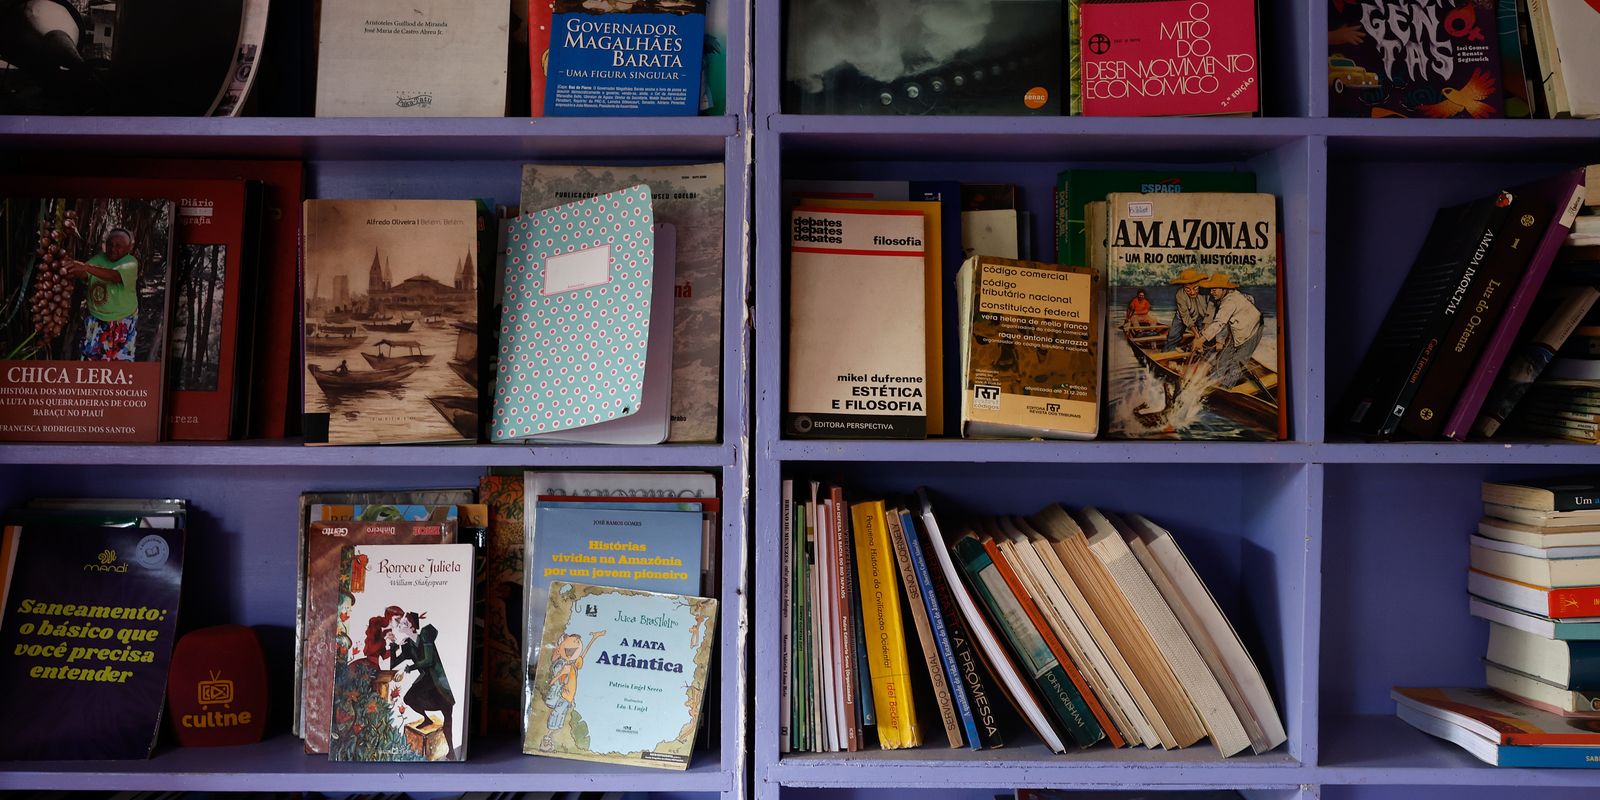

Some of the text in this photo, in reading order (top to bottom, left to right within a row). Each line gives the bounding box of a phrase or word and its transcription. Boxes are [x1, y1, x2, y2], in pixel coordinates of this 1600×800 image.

[1189, 2, 1210, 21] O
[566, 18, 678, 36] GOVERNADOR
[1160, 20, 1211, 40] MITO
[563, 31, 684, 52] MAGALHÃES
[1177, 38, 1211, 58] DO
[612, 50, 684, 69] BARATA
[1086, 54, 1255, 80] DESENVOLVIMENTO
[566, 70, 680, 80] UMA FIGURA SINGULAR
[1086, 75, 1219, 99] ECONÔMICO
[1231, 77, 1255, 99] EDIÇÃO
[181, 198, 214, 207] Diário
[793, 217, 843, 228] debates
[793, 225, 843, 236] debates
[793, 232, 843, 245] debates
[874, 235, 922, 247] filosofia
[1111, 218, 1270, 251] AMAZONAS
[1126, 252, 1257, 266] UM RIO CONTA HISTÓRIAS
[983, 266, 1068, 281] código comercial
[1444, 229, 1496, 318] AMADA IMORTAL
[982, 279, 1017, 290] código
[982, 288, 1073, 304] tributário nacional
[981, 301, 1080, 319] constituição federal
[1454, 279, 1501, 353] Luz do Oriente
[1000, 315, 1027, 324] helena
[1028, 317, 1039, 325] de
[1041, 319, 1062, 328] mello
[1063, 321, 1089, 331] franco
[998, 332, 1089, 348] roque antonio carrazza
[7, 366, 134, 385] CHICA LERA:
[837, 372, 923, 384] mikel dufrenne
[1, 386, 148, 398] HISTÓRIA DOS MOVIMENTOS SOCIAIS
[852, 383, 923, 399] ESTÉTICA
[6, 398, 27, 406] LUTA
[29, 398, 45, 406] DAS
[45, 399, 110, 407] QUEBRADEIRAS
[123, 400, 147, 408] COCO
[831, 399, 923, 412] E FILOSOFIA
[33, 408, 104, 418] BABAÇU NO PIAUÍ
[0, 424, 42, 433] FRANCISCA
[42, 425, 88, 433] RODRIGUES
[106, 426, 136, 434] SANTOS
[814, 418, 895, 430] EDITORA PERSPECTIVA
[1575, 496, 1593, 505] Um
[321, 526, 397, 537] Dinheiro Gente
[864, 514, 877, 546] Pequena
[588, 538, 647, 553] Histórias
[376, 557, 461, 579] Romeu e Julieta
[552, 552, 683, 568] vividas na Amazônia
[869, 547, 881, 577] História
[892, 522, 920, 600] SENO CORNELY
[390, 579, 449, 588] William Shakespeare
[543, 568, 690, 582] por um jovem pioneiro
[18, 598, 168, 622] Saneamento:
[614, 610, 637, 624] Juca
[874, 591, 888, 630] Civilização
[20, 619, 160, 645] o básico que
[14, 641, 156, 664] você precisa
[620, 637, 666, 651] A MATA
[881, 632, 893, 669] Ocidental
[596, 651, 684, 674] Atlântica
[30, 664, 134, 684] entender
[928, 652, 957, 732] SERVIÇO SOCIAL
[953, 638, 999, 739] A PROMESSA
[886, 681, 901, 730] Idel Becker
[1045, 672, 1087, 728] JOHN GRISHAM
[182, 710, 252, 728] cultne
